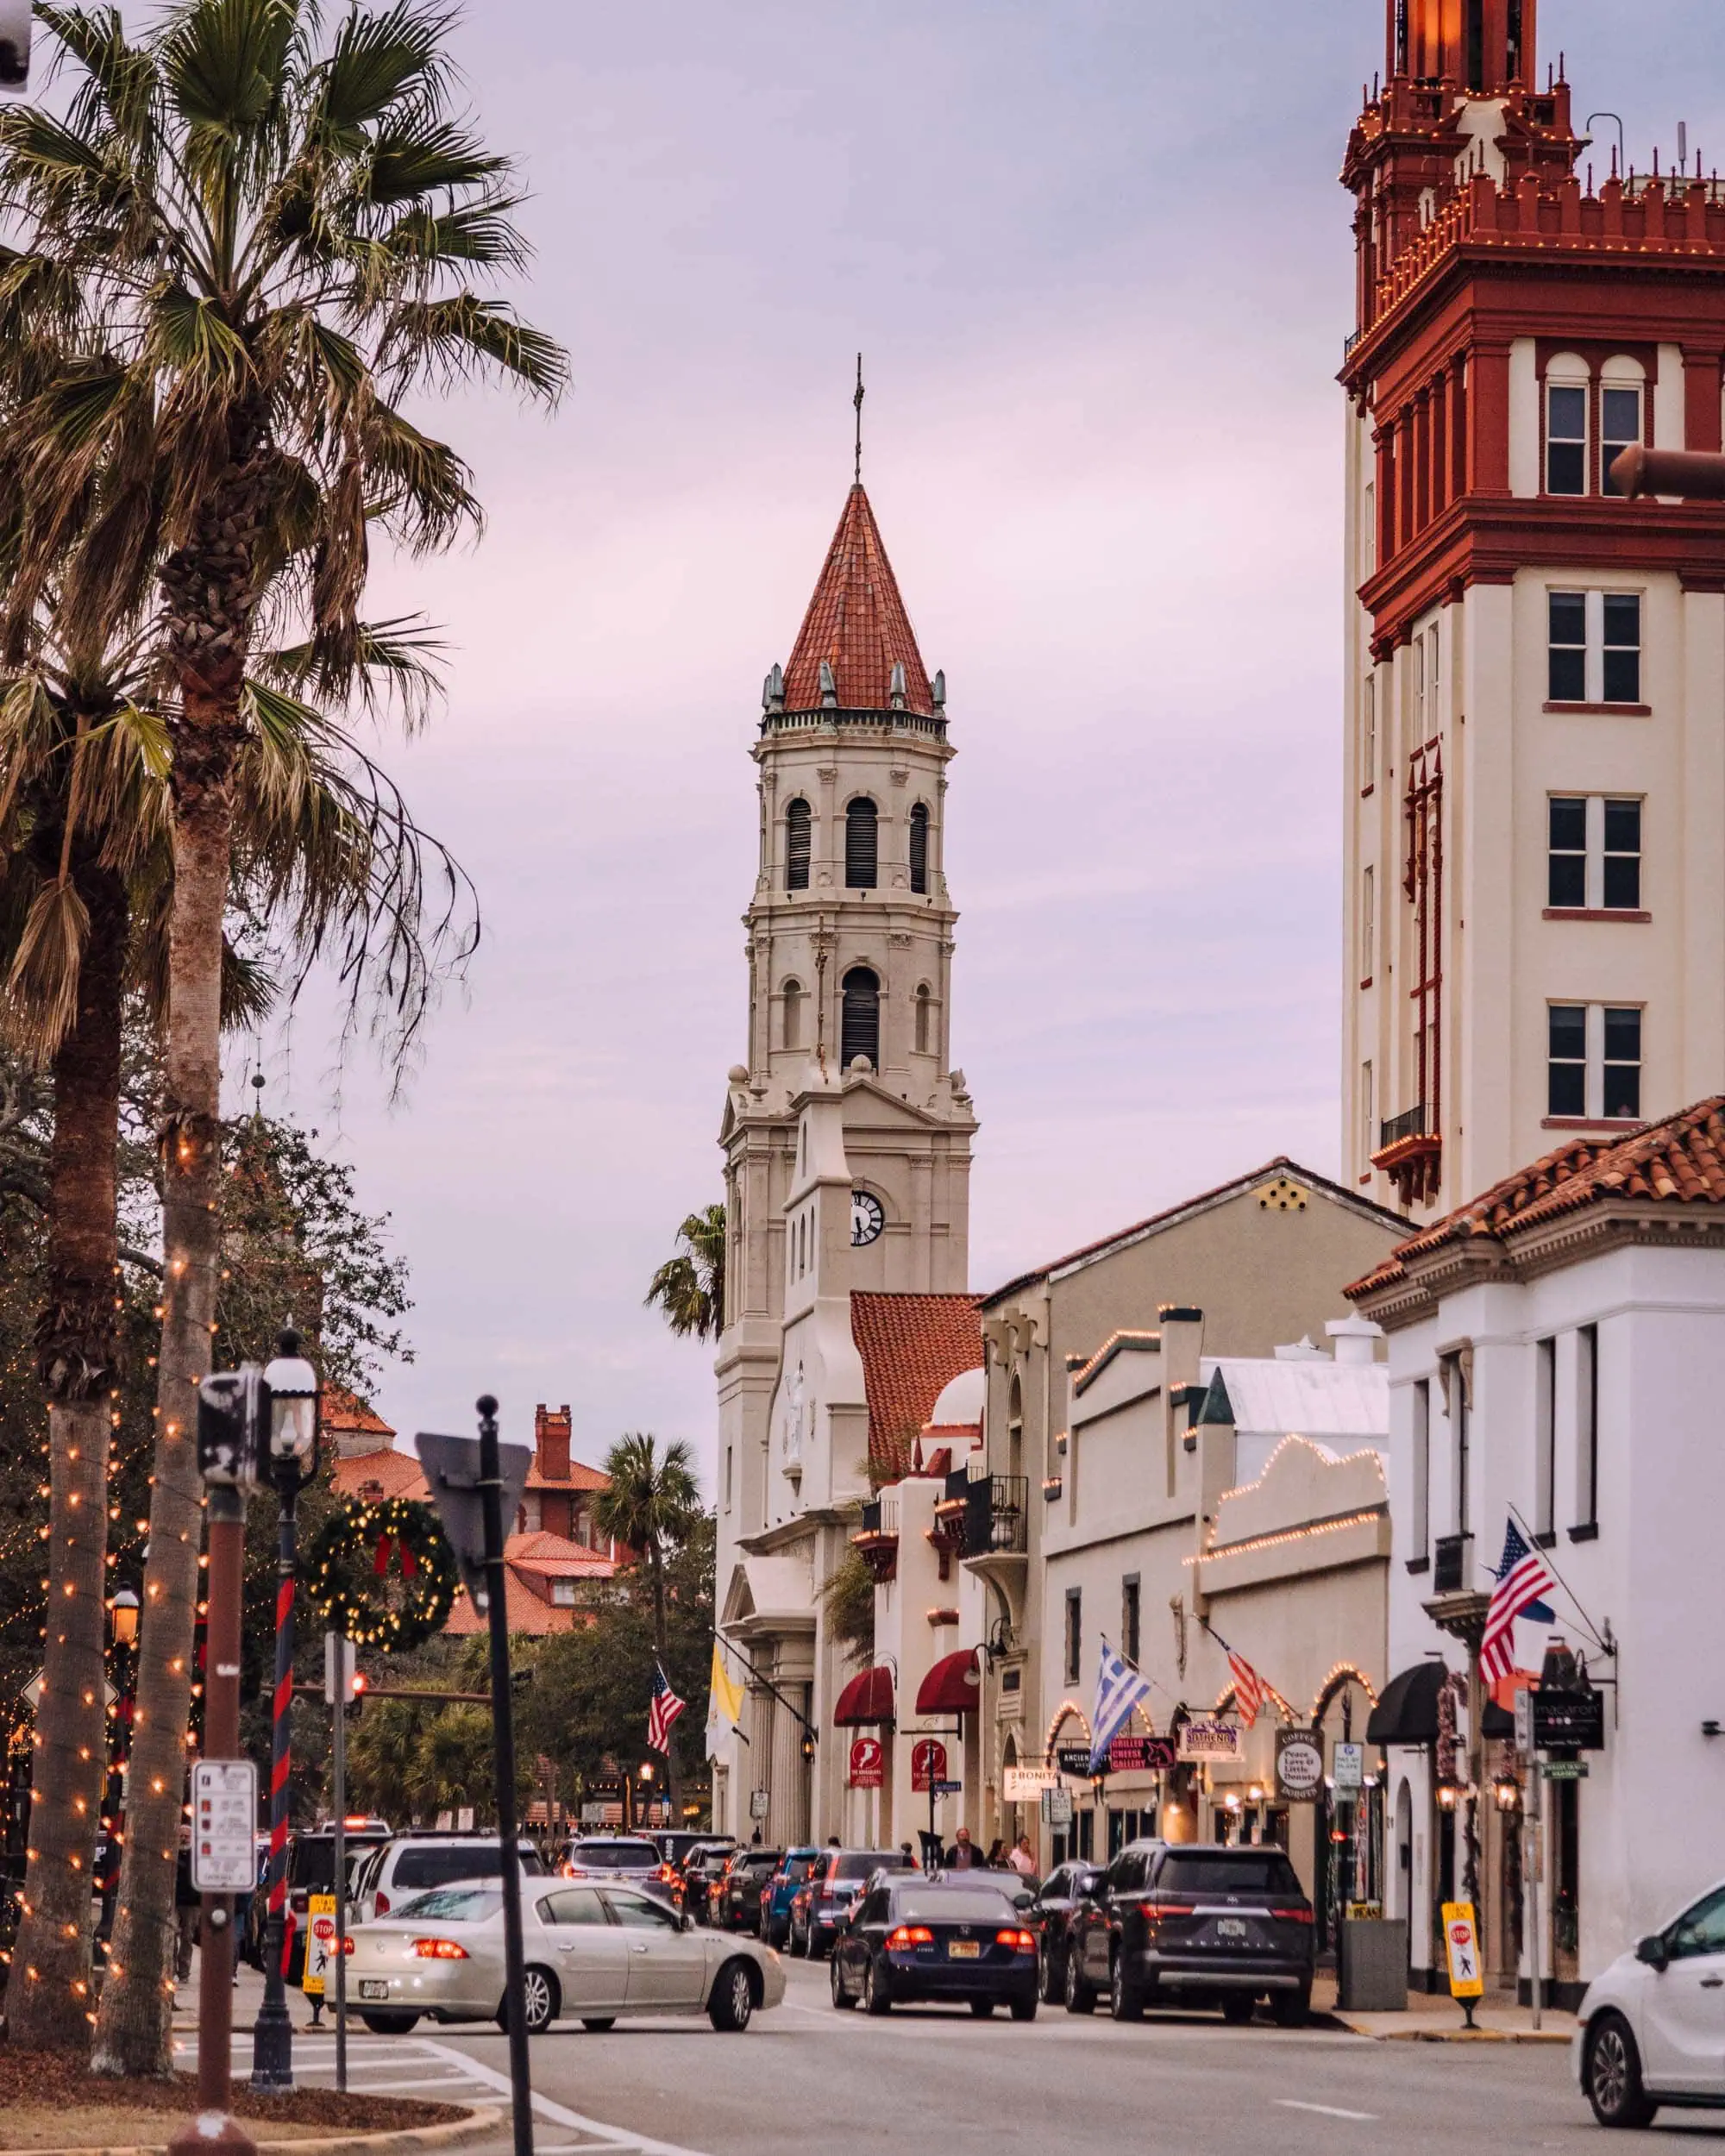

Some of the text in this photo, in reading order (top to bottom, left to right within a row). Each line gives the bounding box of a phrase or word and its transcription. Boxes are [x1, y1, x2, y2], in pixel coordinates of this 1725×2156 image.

[1112, 1738, 1144, 1747] GRILLED
[1282, 1732, 1316, 1744] COFFEE
[1113, 1749, 1142, 1758] CHEESE
[1113, 1759, 1145, 1768] GALLERY
[1281, 1786, 1318, 1799] DONUTS
[315, 1924, 333, 1934] STOP
[1451, 1928, 1471, 1939] STOP
